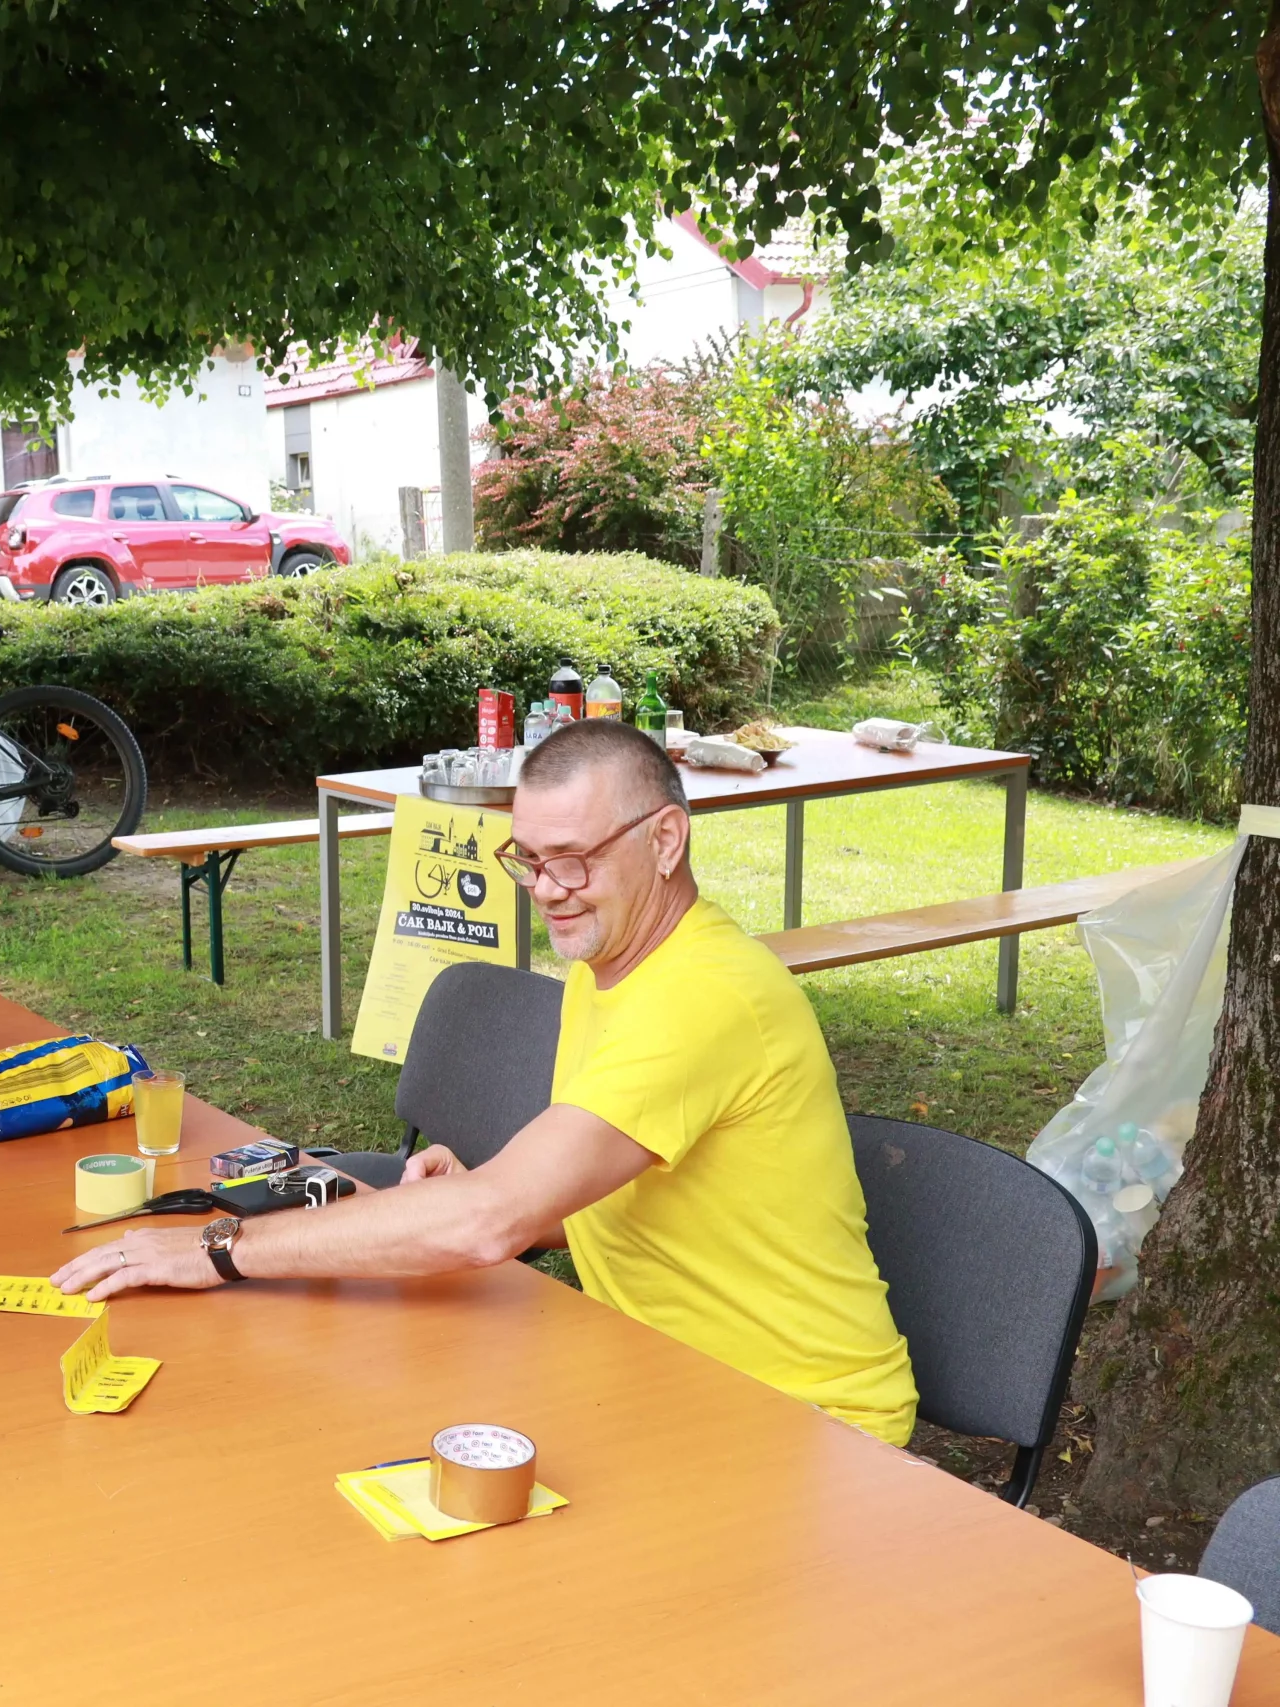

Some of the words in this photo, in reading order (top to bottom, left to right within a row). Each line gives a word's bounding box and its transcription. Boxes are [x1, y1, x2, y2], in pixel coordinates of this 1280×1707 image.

[444, 908, 464, 919] 2024.
[398, 913, 425, 929] ČAK
[426, 918, 456, 933] BAJK
[457, 922, 467, 934] &
[467, 923, 495, 939] POLI
